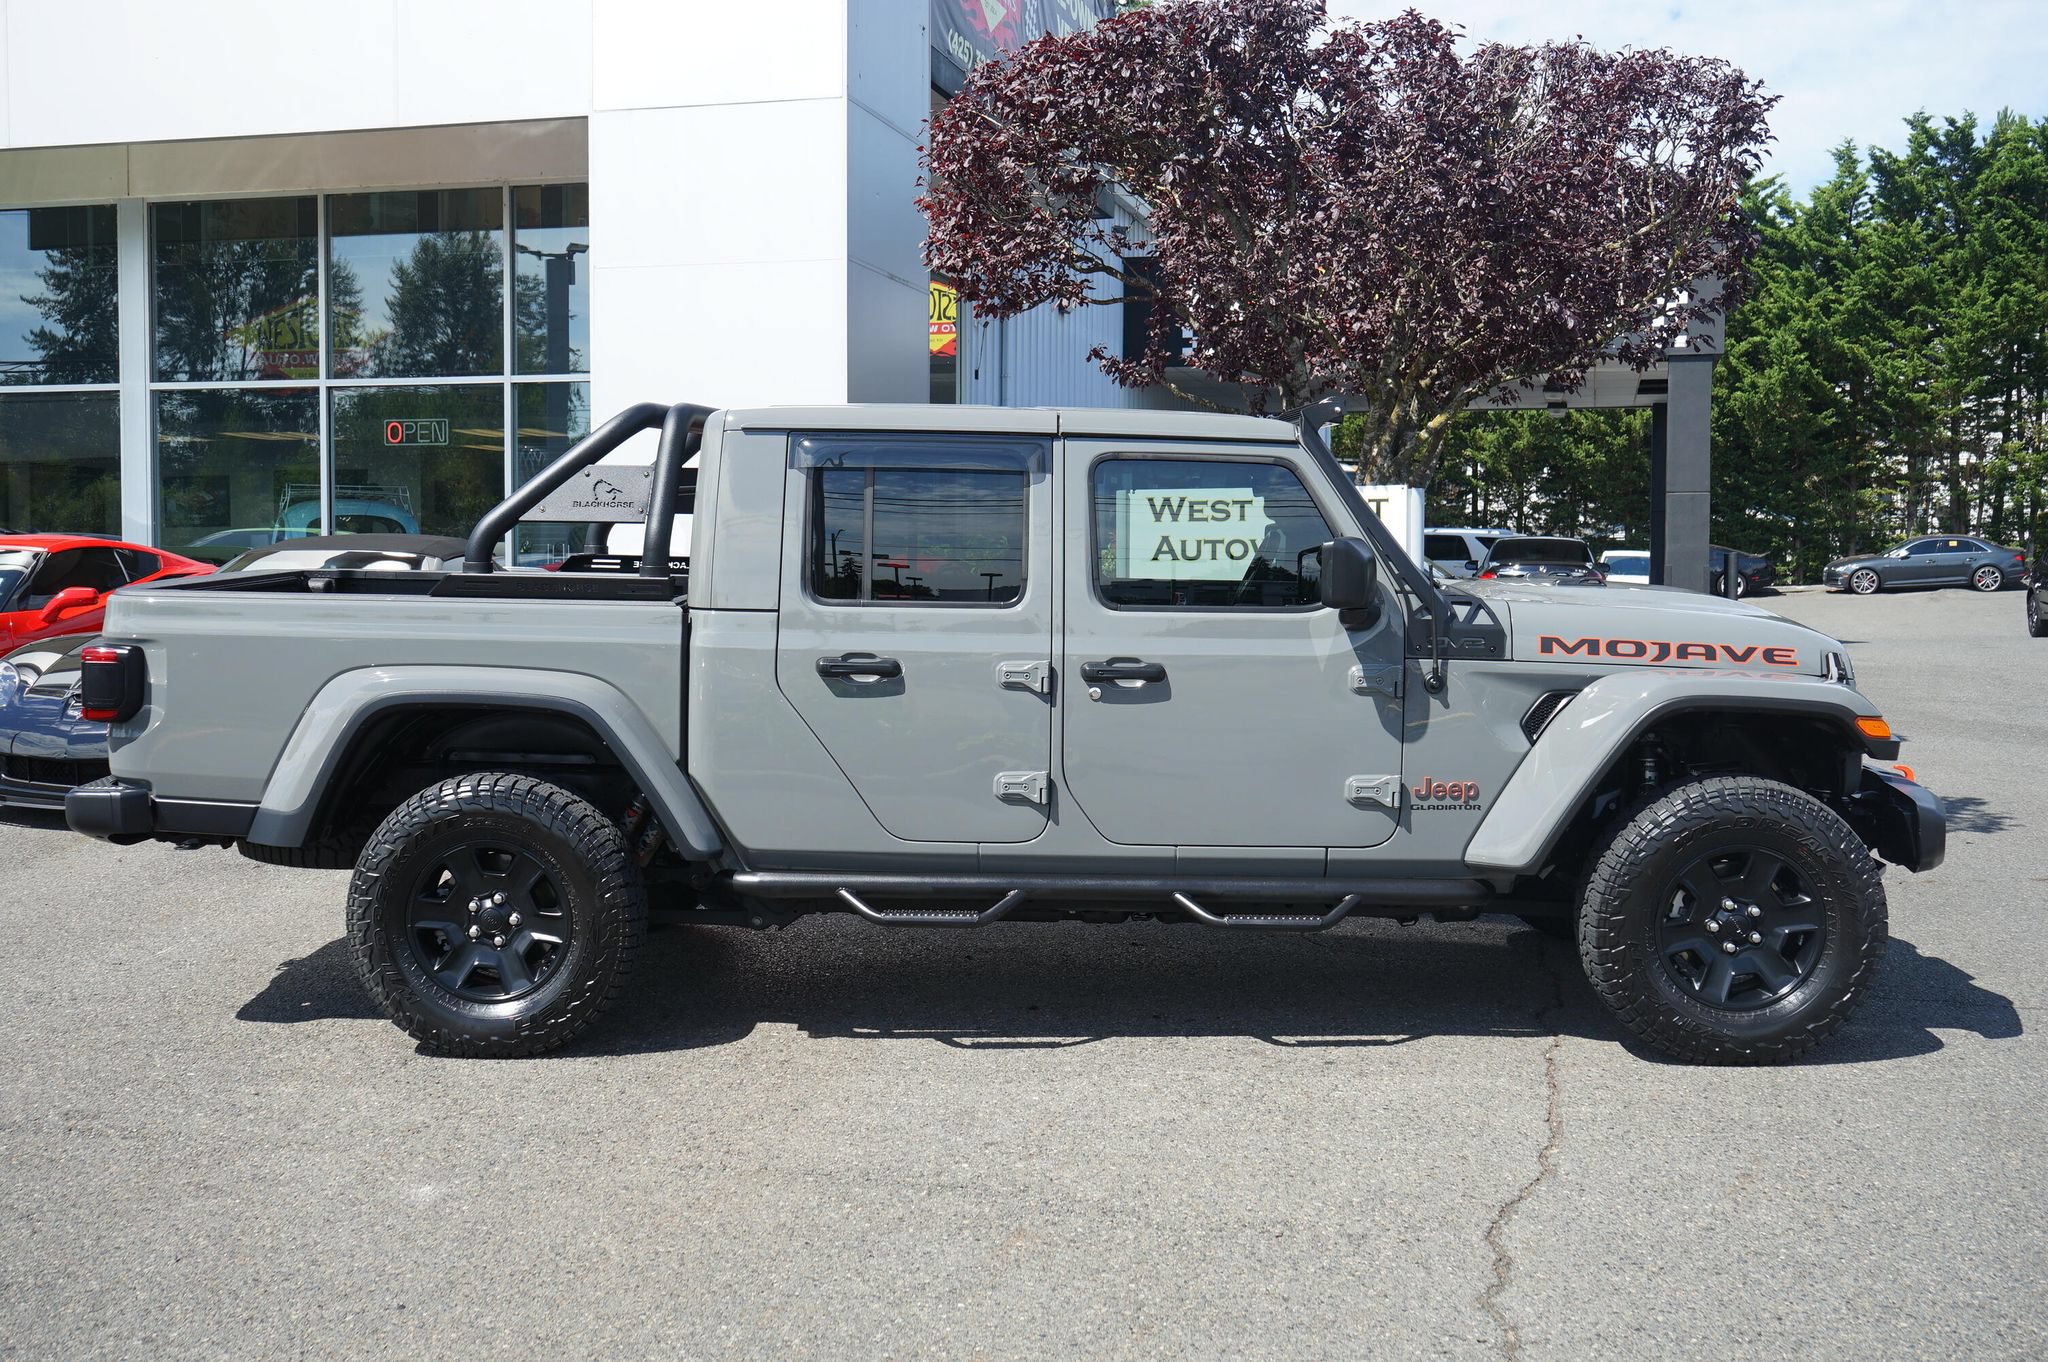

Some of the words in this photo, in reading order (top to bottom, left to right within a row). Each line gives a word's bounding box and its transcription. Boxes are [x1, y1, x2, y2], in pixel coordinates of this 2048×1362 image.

[386, 421, 445, 443] OPEN
[572, 500, 635, 509] BLACKHORSE
[1146, 496, 1254, 523] WEST
[1539, 636, 1799, 666] MOJAVE
[1412, 776, 1480, 804] Jeep
[1410, 803, 1482, 811] GLADIATOR
